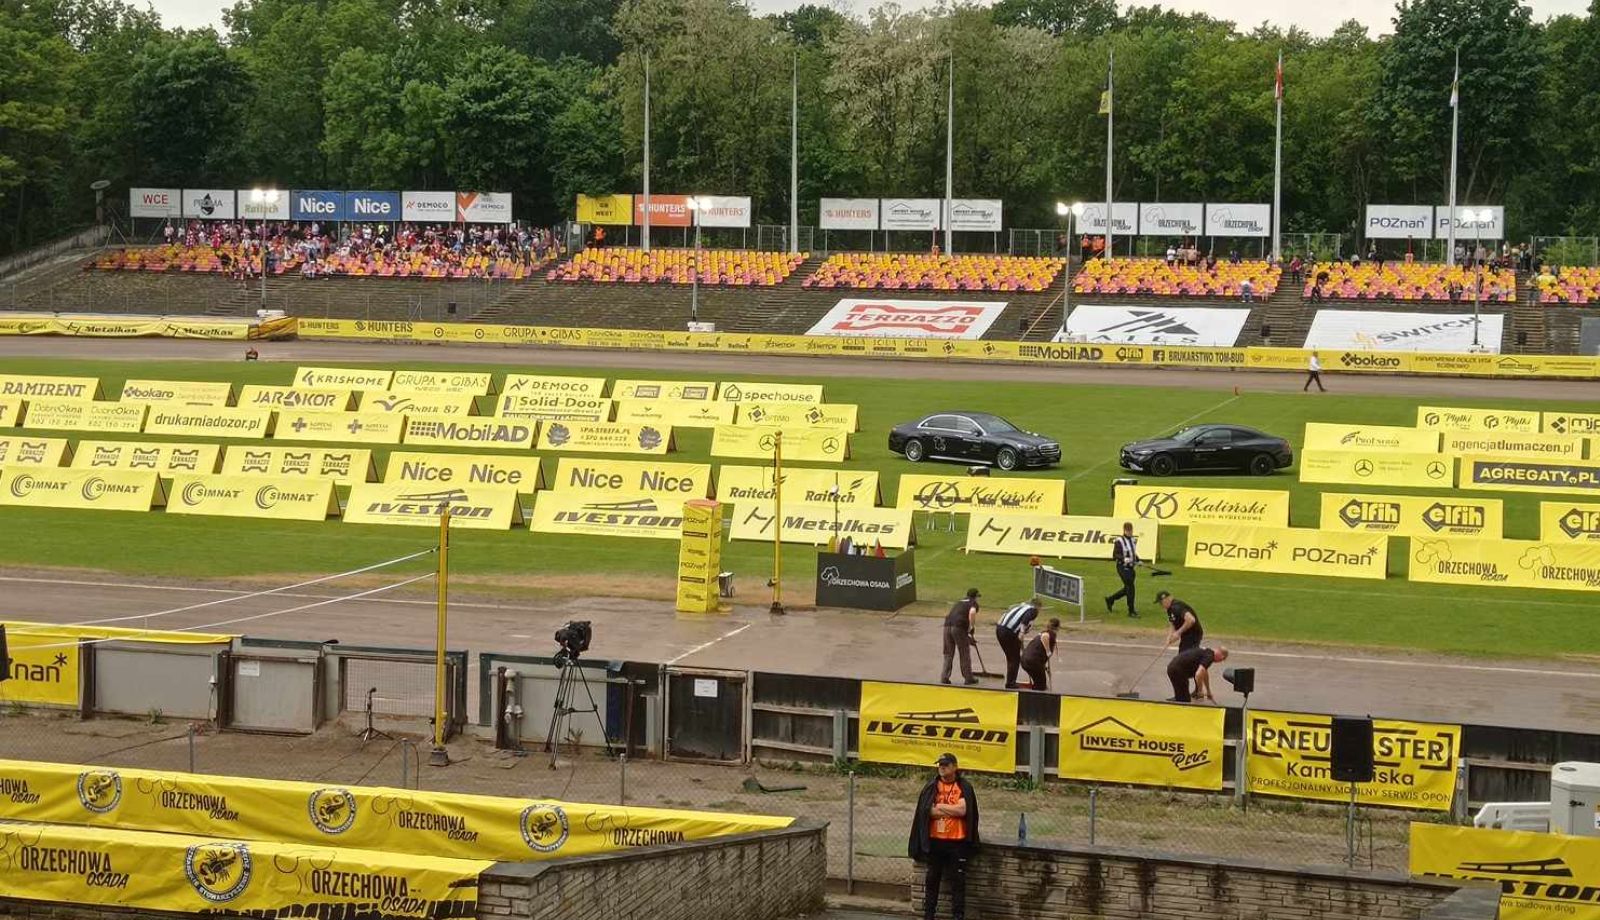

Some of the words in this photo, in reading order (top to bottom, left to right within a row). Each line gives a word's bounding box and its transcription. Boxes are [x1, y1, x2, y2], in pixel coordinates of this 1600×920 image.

[143, 194, 168, 205] WCE
[300, 198, 335, 213] Nice
[354, 198, 391, 214] Nice
[648, 203, 686, 213] HUNTERS
[1094, 219, 1126, 227] ORZEOWA
[1158, 219, 1190, 228] ORZECHOWA
[1224, 220, 1257, 228] ORZECHOWA
[308, 322, 339, 330] HUNTERS
[846, 313, 977, 324] TERRAZZO
[368, 321, 413, 333] HUNTERS
[503, 328, 538, 338] GRUPA
[550, 329, 582, 340] GIBAS
[1376, 317, 1483, 343] SWITCH
[1168, 351, 1213, 362] BRUKARSTWO
[1215, 352, 1245, 363] TOM-BUD
[1353, 355, 1400, 368] bokaro
[316, 375, 385, 386] KRISHOME
[396, 375, 436, 386] GRUPA
[451, 376, 487, 388] GIBAS
[532, 381, 589, 392] DEMOCO
[2, 382, 86, 397] RAMIRENT
[134, 388, 174, 399] bokaro
[520, 396, 604, 409] Solid-Door
[155, 413, 261, 431] drukarniadozor.pl
[400, 462, 453, 481] Nice
[469, 464, 522, 484] Nice
[570, 467, 623, 489] Nice
[640, 471, 694, 492] Nice
[25, 481, 68, 490] SIMNAT
[96, 484, 139, 494] SIMNAT
[197, 489, 240, 498] SIMNAT
[270, 491, 314, 502] SIMNAT
[730, 487, 777, 500] Raitech
[805, 490, 855, 503] Raitech
[367, 502, 493, 518] IVESTON
[1187, 496, 1267, 514] Kaliński
[1345, 501, 1400, 523] elfih
[553, 512, 683, 528] IVESTON
[1429, 504, 1485, 526] elfih
[782, 516, 895, 534] Metalkas
[1020, 527, 1138, 544] Metalka
[1438, 559, 1497, 576] ORZECHOWA
[832, 578, 869, 587] ORZECHOWA
[870, 580, 890, 589] OSADA
[866, 721, 1009, 743] IVESTON
[1086, 736, 1134, 748] INVEST
[1138, 740, 1184, 752] HOUSE
[1260, 728, 1445, 761] PNEUSTER
[1251, 776, 1333, 793] PROFESJONALNY
[1335, 786, 1378, 797] MOILNY
[1382, 791, 1418, 800] SERWIS
[1422, 793, 1451, 802] OPON
[11, 793, 40, 804] OSADA
[162, 790, 227, 812] ORZECHOWA
[209, 808, 239, 821] OSADA
[399, 811, 466, 832] ORZECHOWA
[447, 829, 479, 843] OSADA
[613, 827, 686, 847] ORZECHOWA
[20, 846, 112, 875] ORZECHOWA
[86, 871, 129, 889] OSADA
[311, 870, 409, 899] ORZECHOWA
[380, 896, 427, 913] OSADA
[1516, 900, 1552, 911] budowa
[1555, 902, 1576, 914] dróg
